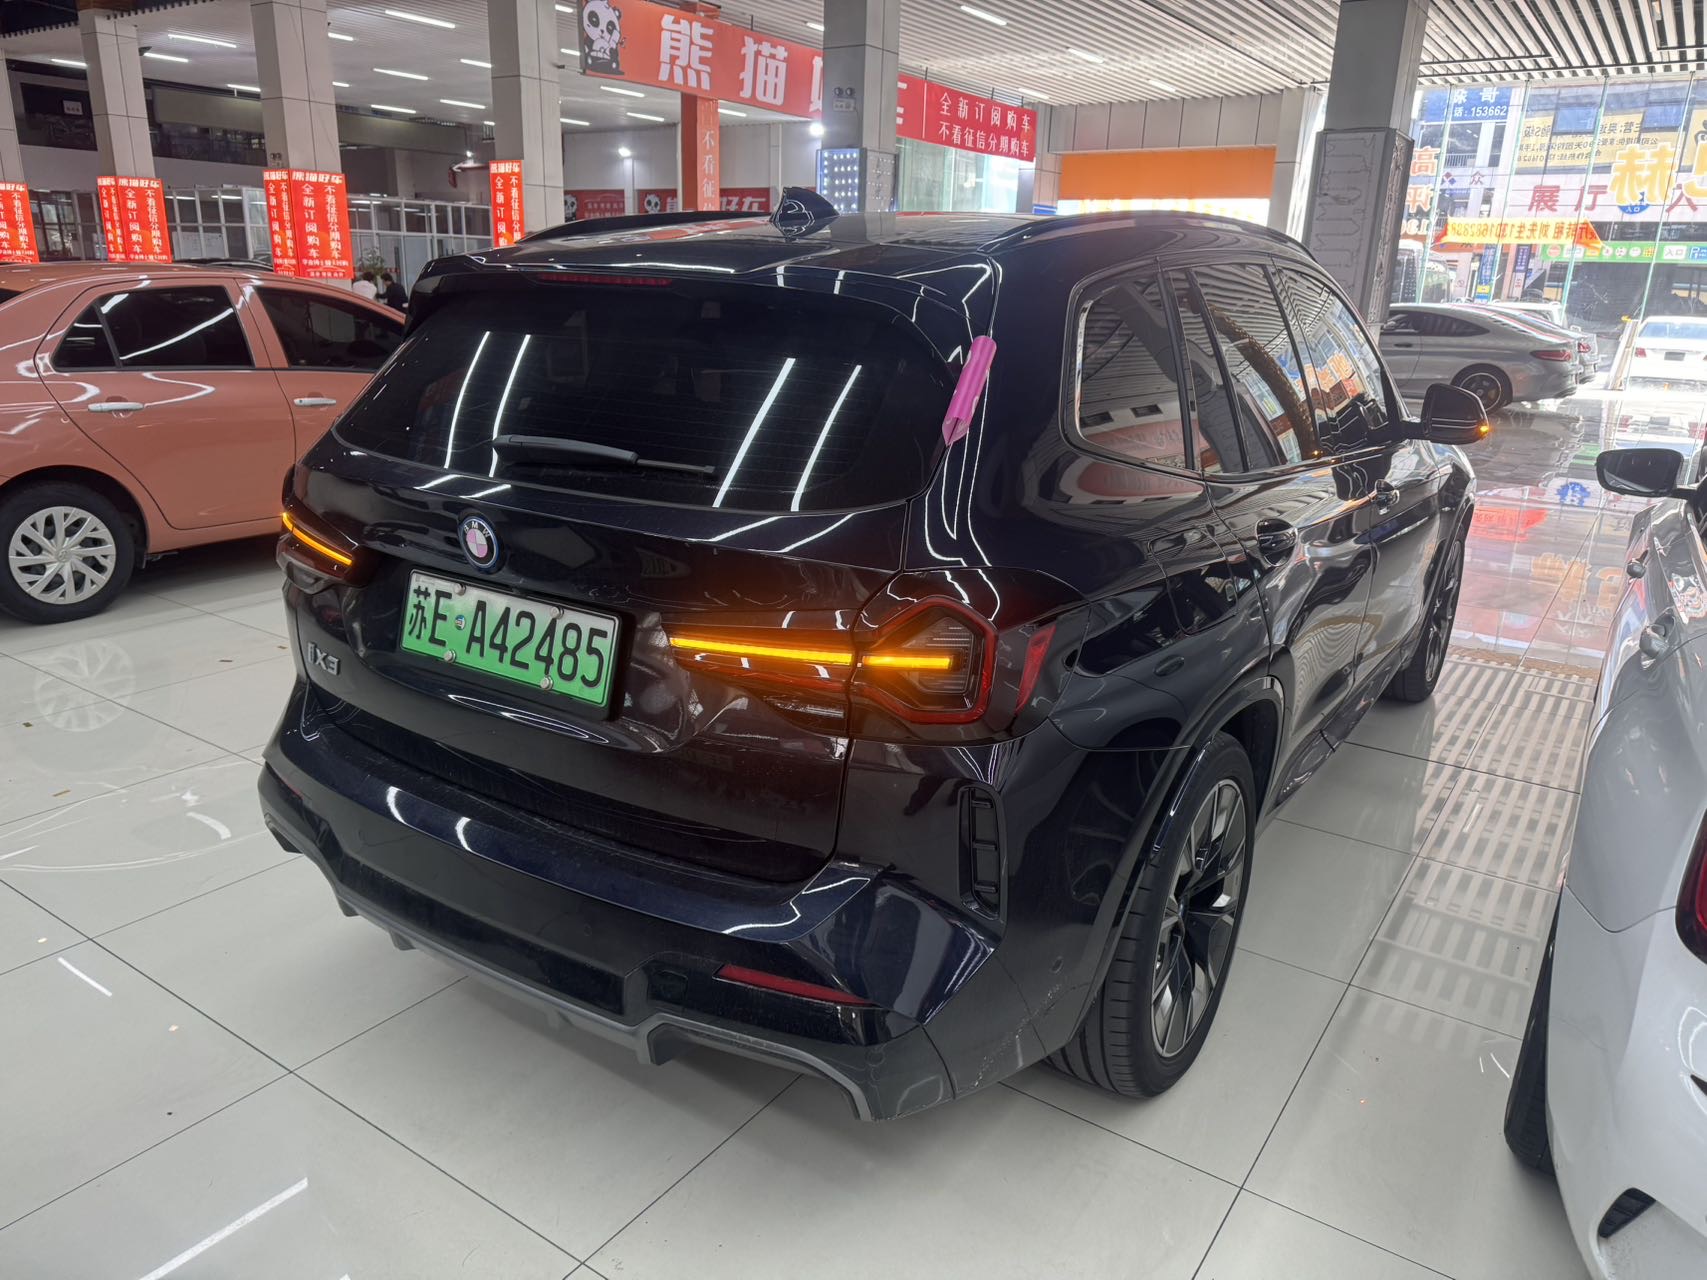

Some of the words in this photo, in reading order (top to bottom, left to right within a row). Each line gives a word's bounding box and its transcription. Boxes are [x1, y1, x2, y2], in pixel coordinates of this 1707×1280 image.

[658, 14, 822, 112] 熊猫
[939, 91, 1031, 133] 全新订阅购车
[938, 121, 1029, 157] 不看征信分期购车
[125, 188, 143, 253] 全新订阅购车
[302, 183, 320, 258] 全新订阅购车
[464, 521, 491, 539] BMW
